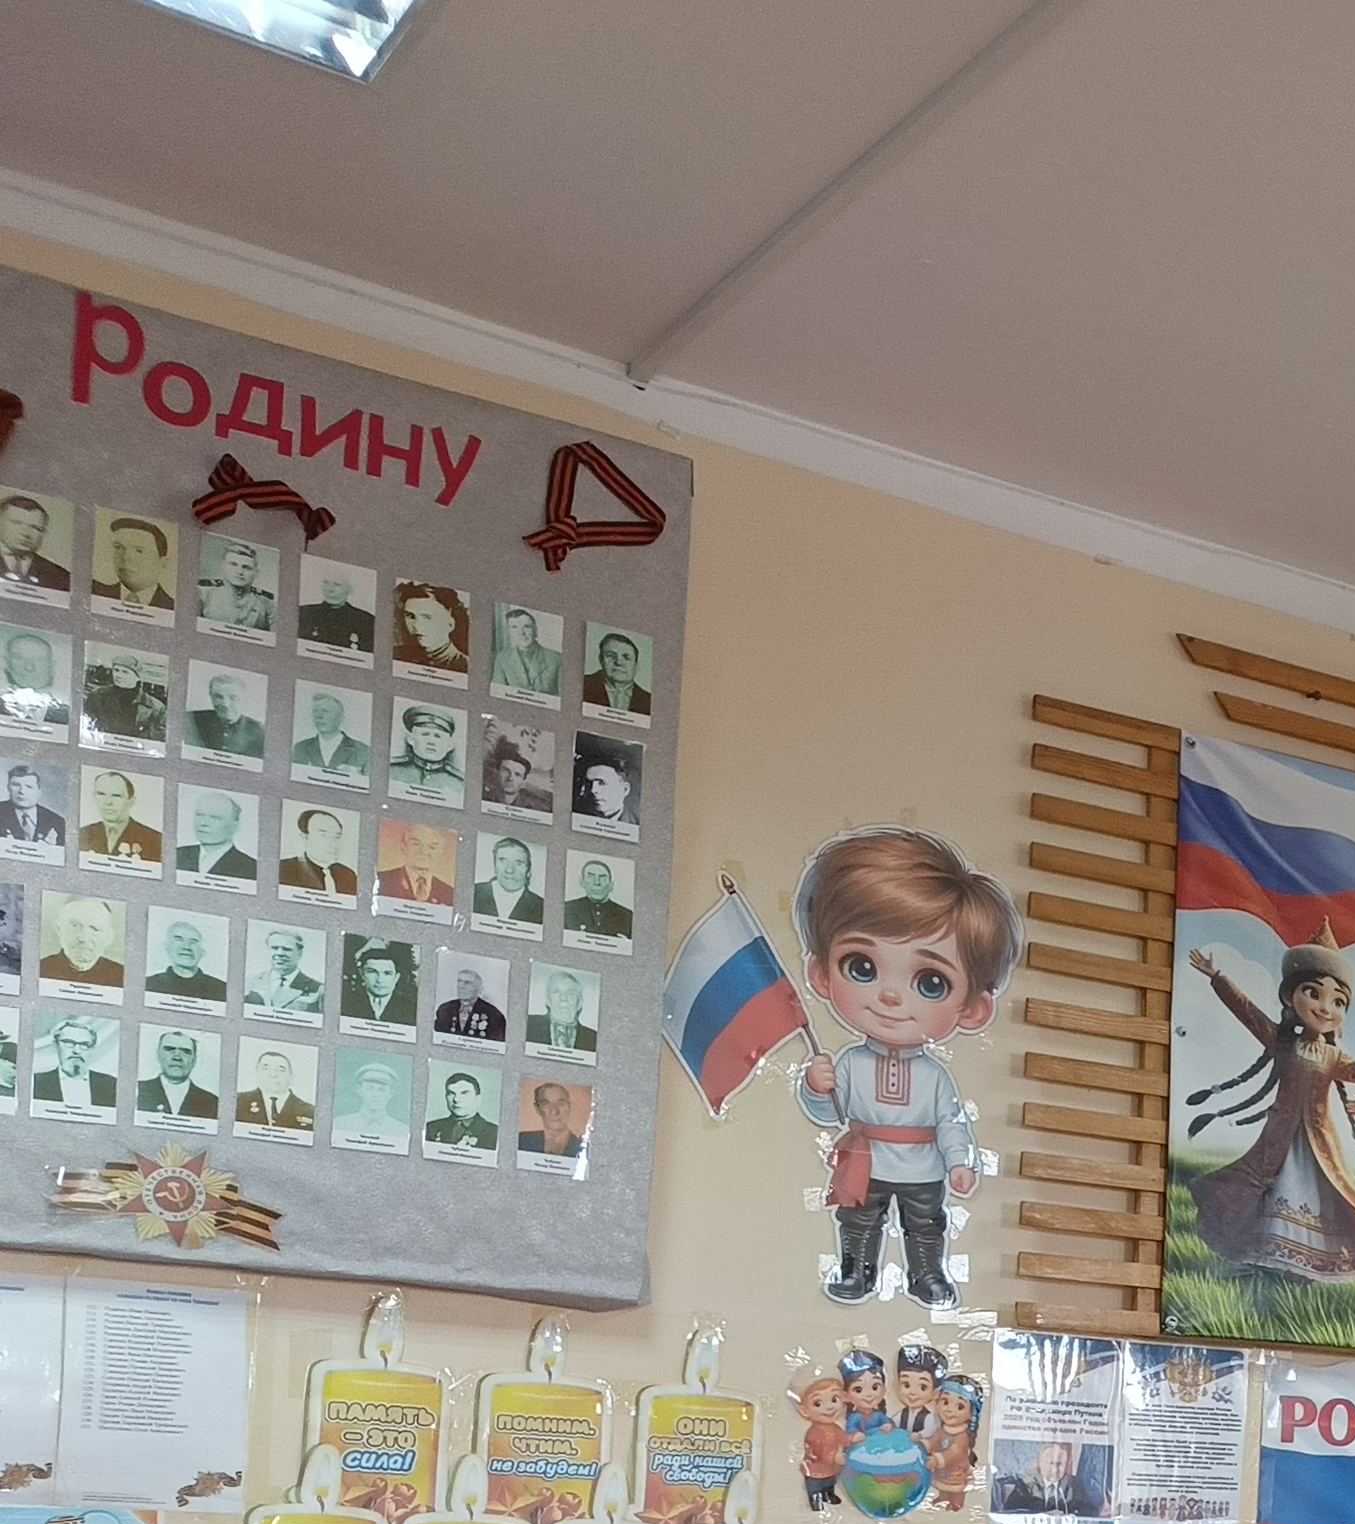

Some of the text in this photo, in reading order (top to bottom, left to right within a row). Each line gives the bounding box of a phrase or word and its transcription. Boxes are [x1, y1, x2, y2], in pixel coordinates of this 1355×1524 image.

[71, 290, 481, 506] Родину
[329, 1401, 435, 1426] ПАМЯТЬ
[676, 1416, 727, 1437] ОНИ
[367, 1428, 416, 1449] ЭТО
[649, 1436, 716, 1452] ОТДАЛИ
[344, 1452, 415, 1472] сила!
[489, 1459, 598, 1478] не забудем!
[652, 1453, 744, 1471] ради нашей
[665, 1467, 733, 1488] свободы!
